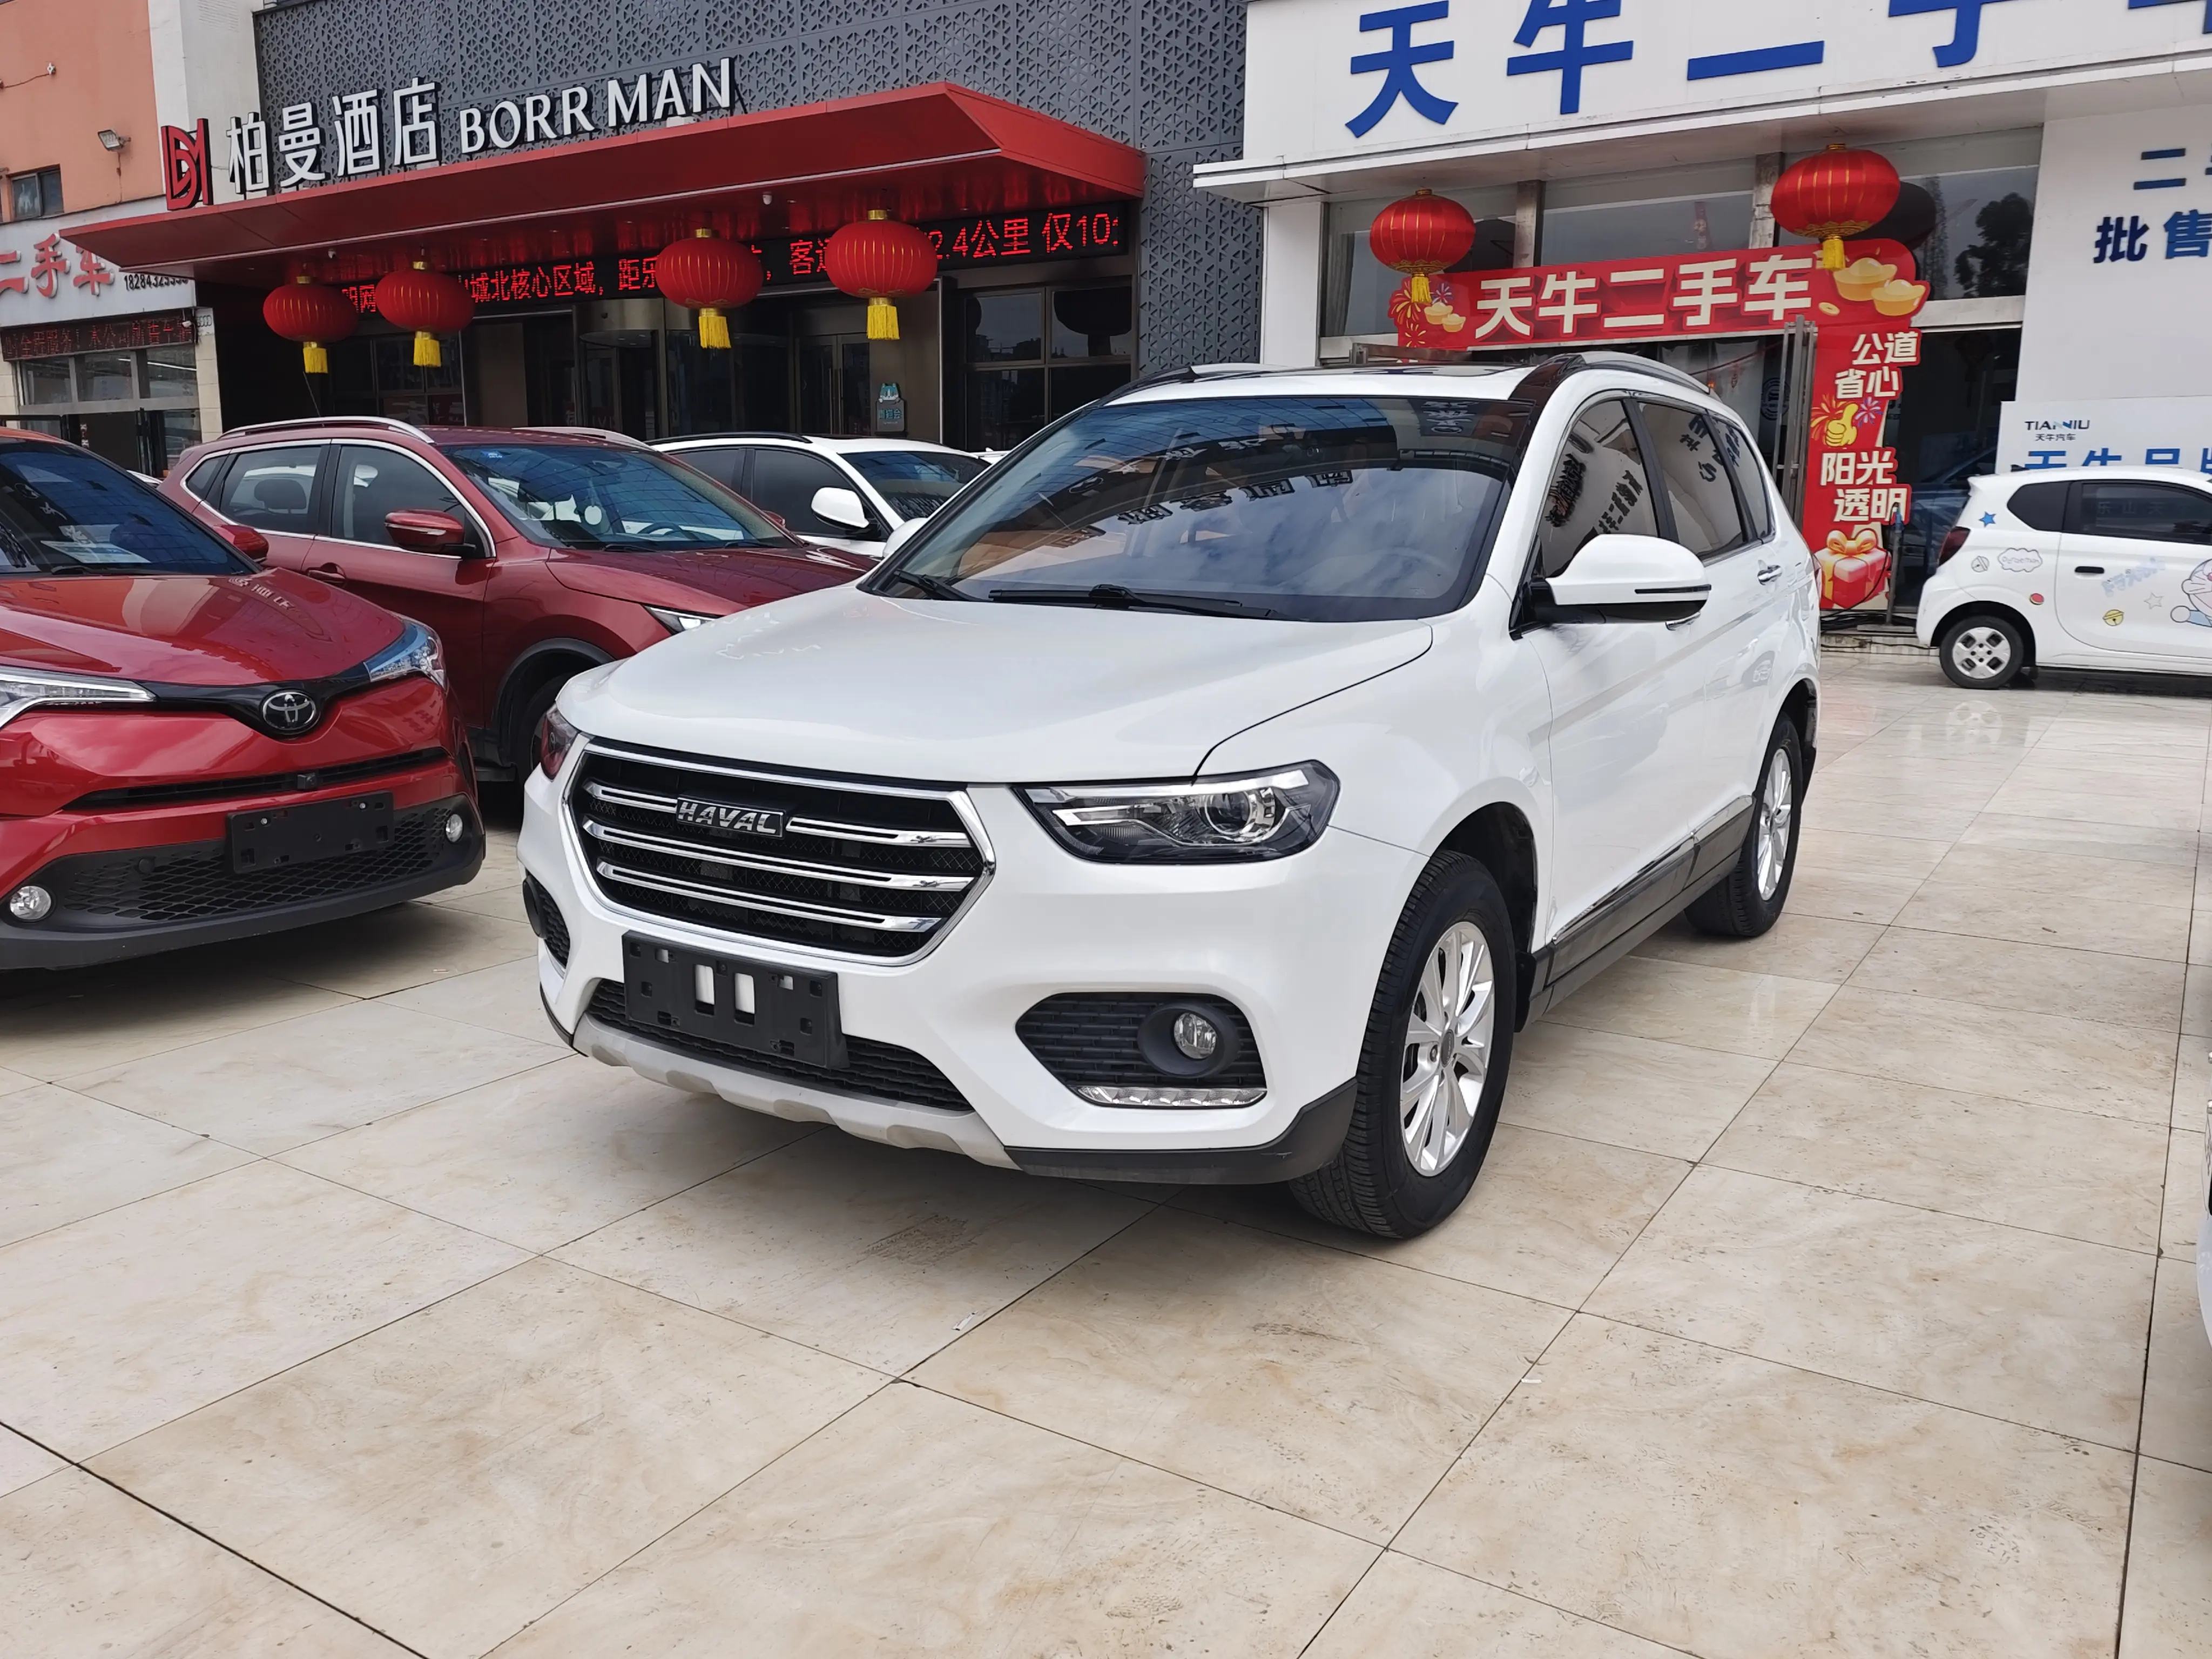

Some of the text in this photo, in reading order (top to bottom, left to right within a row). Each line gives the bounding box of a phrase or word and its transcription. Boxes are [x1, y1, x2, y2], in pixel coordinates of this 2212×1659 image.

[227, 77, 438, 195] 柏曼酒店
[1475, 254, 1813, 340] 天牛二手车
[1851, 331, 1918, 365] 公道
[1835, 366, 1899, 399] 省心
[2035, 433, 2076, 441] 天牛汽车
[1821, 450, 1893, 485] 阳光
[1833, 488, 1906, 522] 透明
[678, 801, 777, 834] HAVAL
